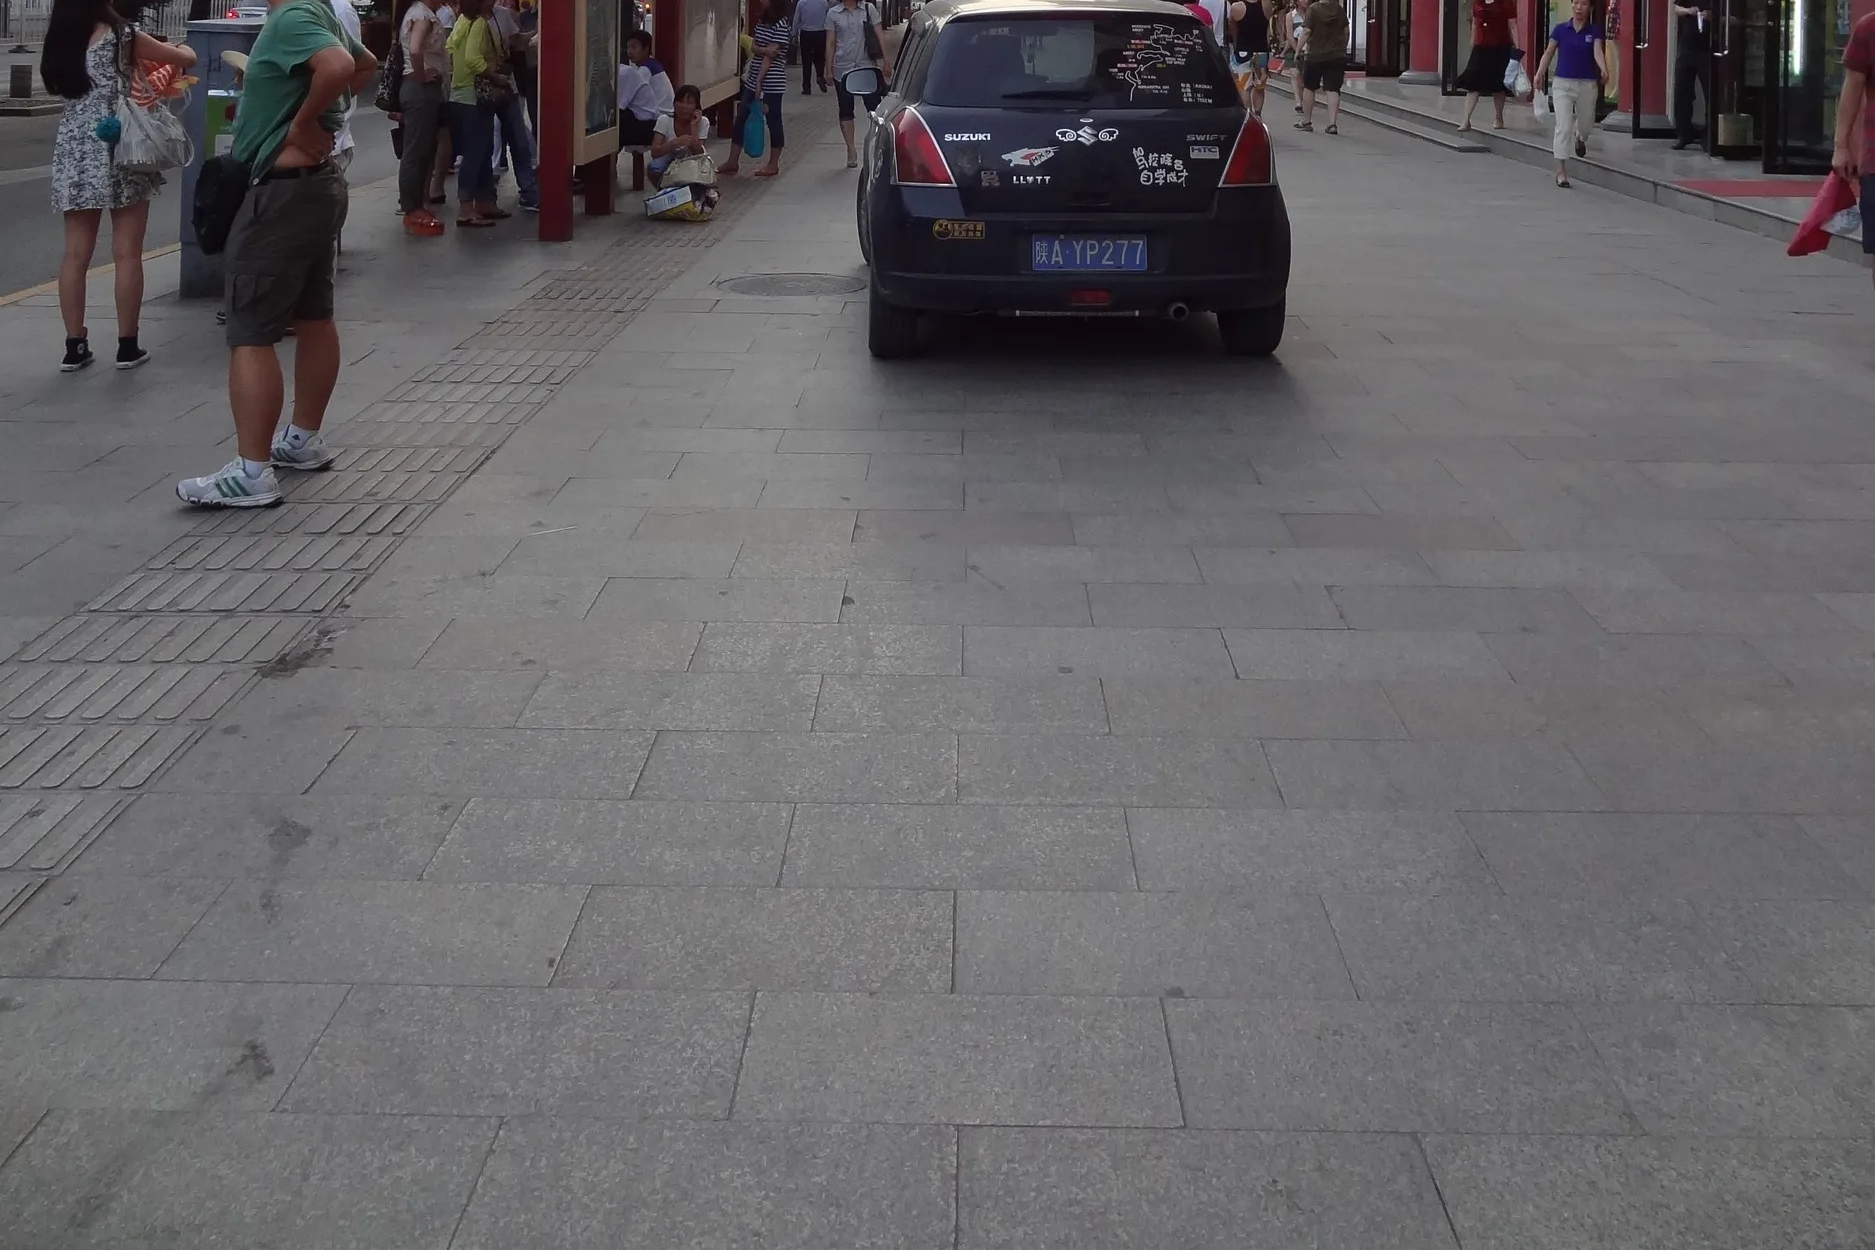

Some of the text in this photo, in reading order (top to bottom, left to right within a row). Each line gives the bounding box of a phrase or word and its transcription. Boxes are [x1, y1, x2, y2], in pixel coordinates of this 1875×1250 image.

[944, 133, 991, 141] SUZUKI
[1140, 168, 1189, 187] 自学成才
